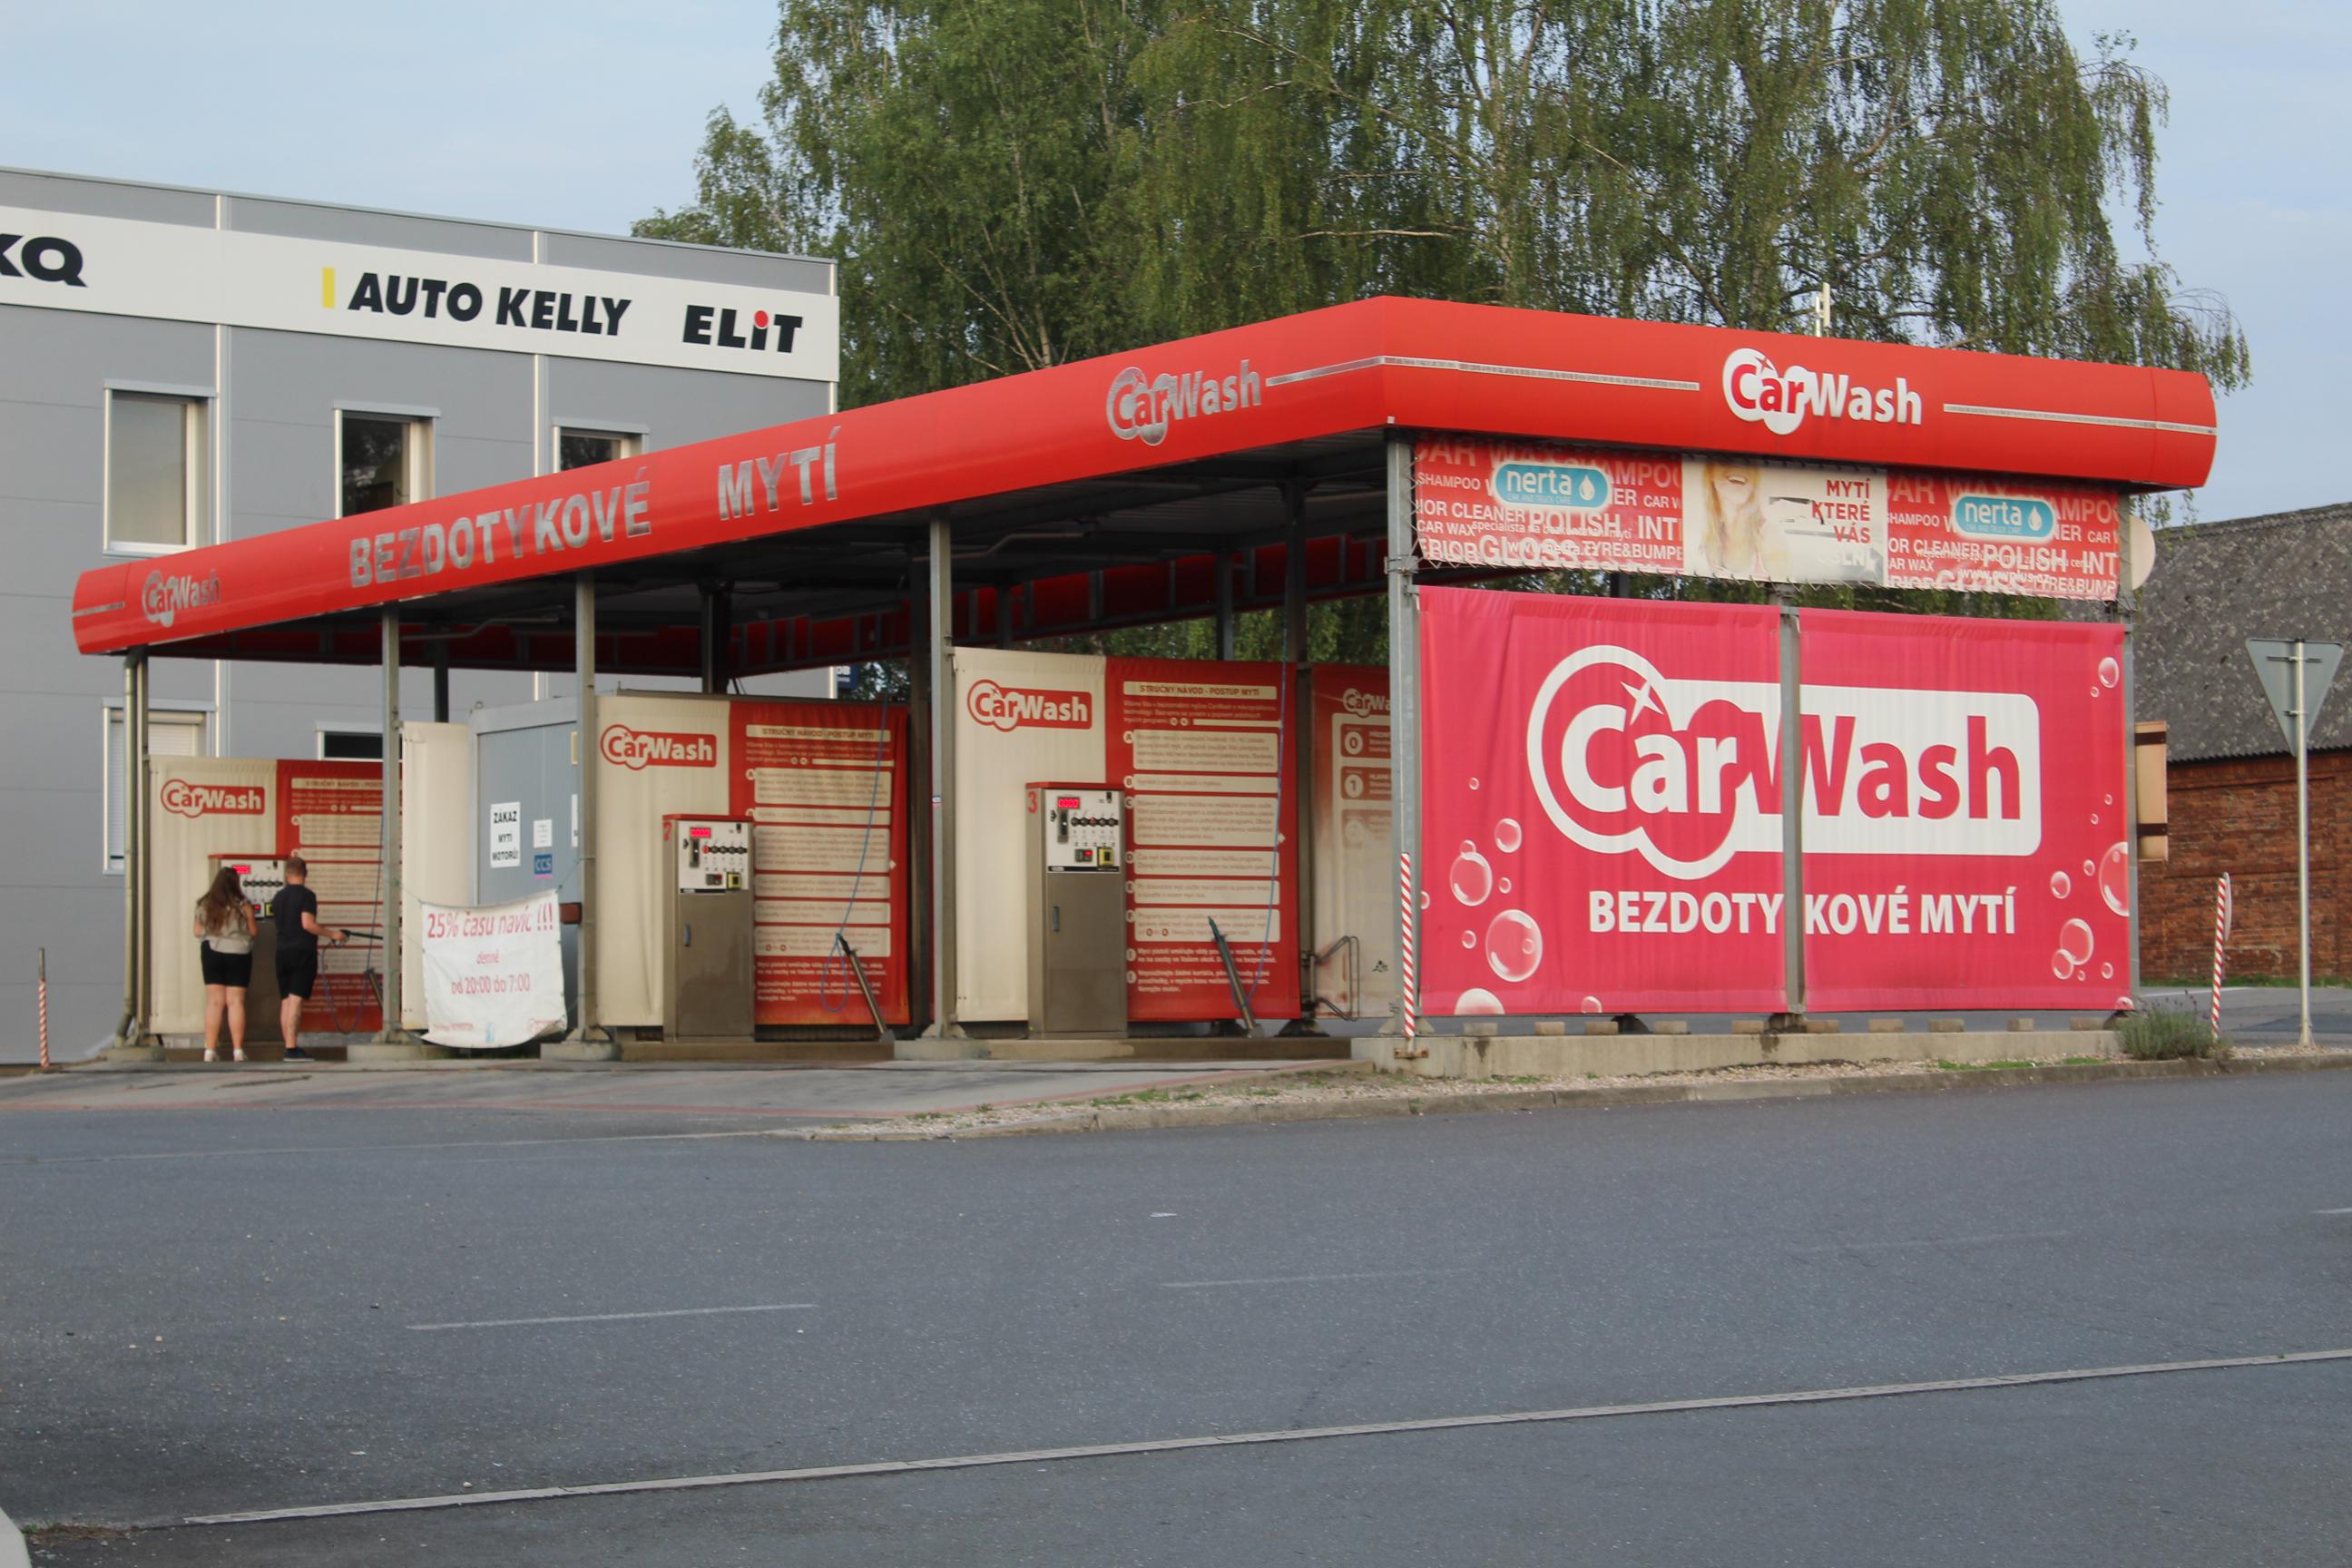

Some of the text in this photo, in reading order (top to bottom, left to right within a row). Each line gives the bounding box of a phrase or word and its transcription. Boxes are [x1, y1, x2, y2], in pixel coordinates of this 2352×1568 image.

[348, 272, 632, 336] AUTO KELLY
[1108, 359, 1260, 440] CarWash
[1726, 351, 1922, 433] CarWash
[1506, 469, 1573, 495] nerta
[1827, 478, 1871, 499] MYTÍ
[349, 426, 840, 589] BEZDOTYKOVÉ MYTÍ
[1452, 502, 1525, 524] CLEANER
[1643, 495, 1670, 509] CAR
[1811, 501, 1871, 522] KTERÉ
[1965, 501, 2023, 526] nerta
[1416, 519, 1475, 537] CAR WAX
[1529, 508, 1622, 538] POLISH
[1834, 522, 1871, 544] VÁS
[2087, 530, 2112, 544] CAR
[1479, 534, 1579, 566] GLOSS
[1913, 539, 1981, 559] CLEANER
[1984, 544, 2068, 573] POLISH
[1887, 558, 1935, 573] AR WAX
[142, 572, 220, 623] CarWash
[972, 692, 1089, 725] CarWash
[604, 732, 714, 765] CarWash
[1555, 693, 2027, 828] CarWash
[163, 782, 263, 813] CarWash
[1027, 791, 1038, 813] 3
[427, 912, 459, 938] 25%
[463, 911, 495, 937] času
[499, 905, 533, 933] navíc
[1921, 887, 2016, 935] MYTÍ
[451, 973, 530, 995] od 20:00 do 7:00
